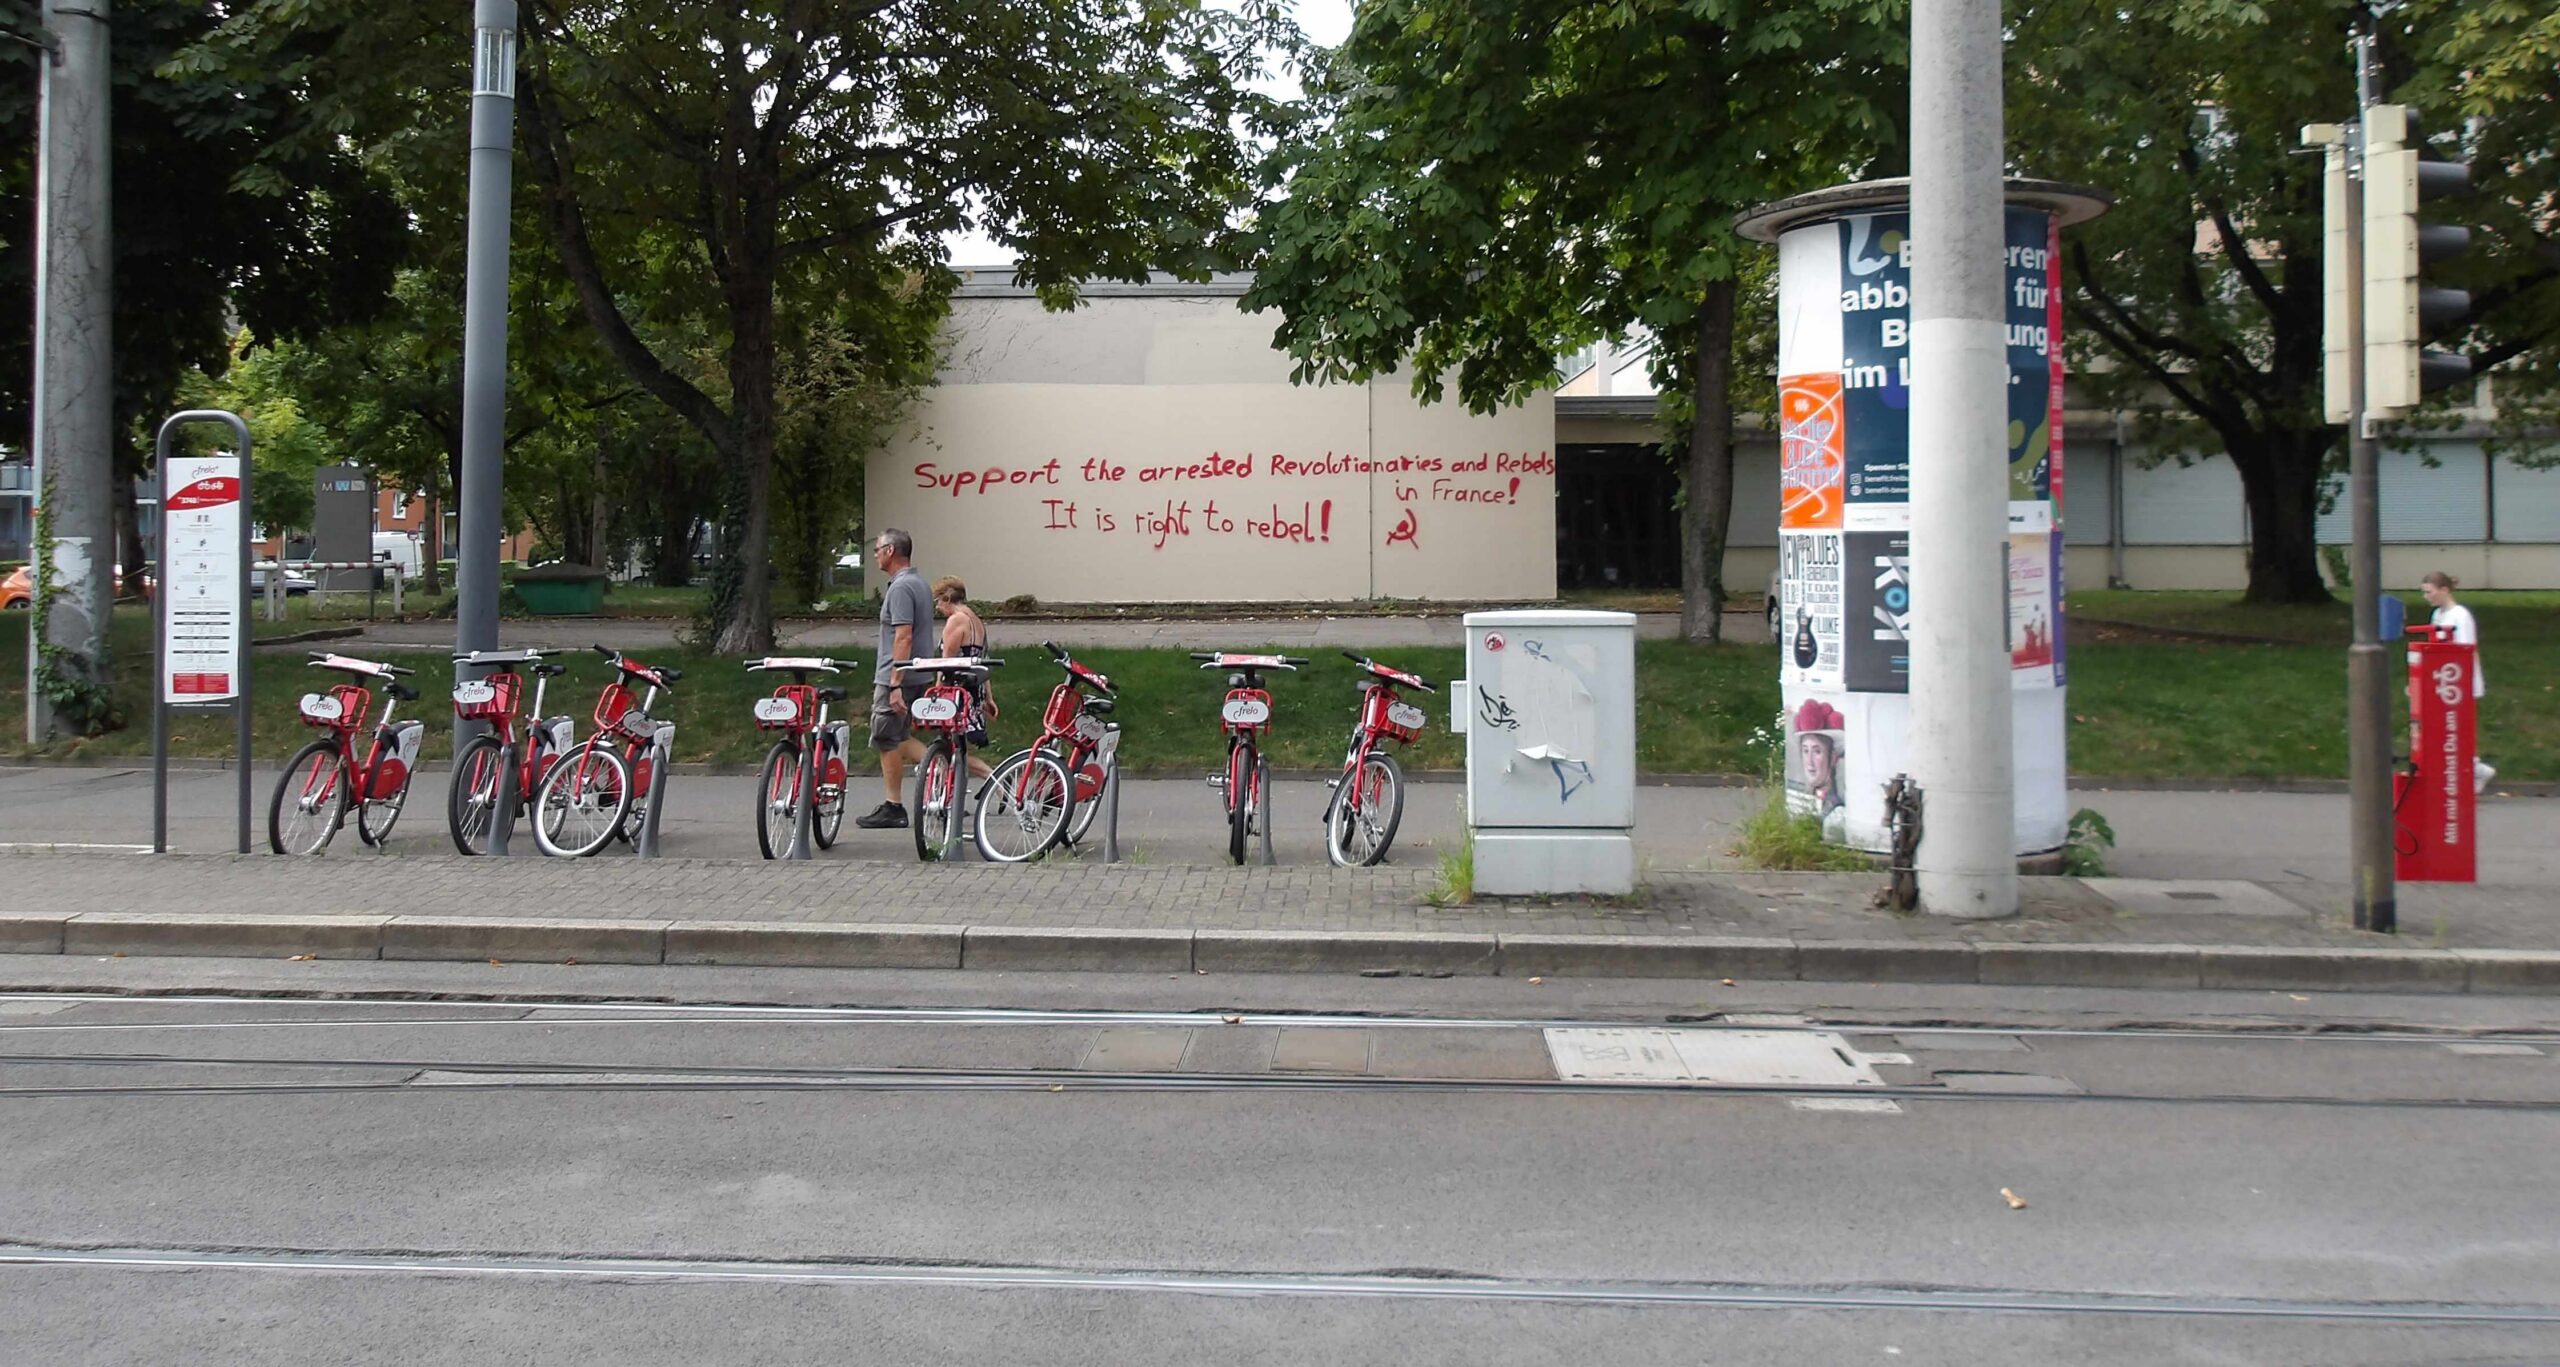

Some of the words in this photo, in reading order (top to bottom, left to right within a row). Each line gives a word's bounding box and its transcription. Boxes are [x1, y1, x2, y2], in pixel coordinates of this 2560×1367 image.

[2014, 277, 2048, 309] für
[1842, 358, 1887, 388] im
[914, 457, 1060, 496] Support
[1081, 457, 1126, 482] the
[1138, 452, 1253, 482] arrested
[1270, 452, 1443, 477] Revolutionaries
[1451, 452, 1488, 473] and
[1496, 451, 1556, 475] Rebels
[1395, 478, 1418, 501] in
[1432, 477, 1521, 505] France!
[1043, 498, 1077, 530] It
[1096, 506, 1117, 532] is
[1136, 499, 1191, 549] right
[1204, 500, 1234, 533] to
[1246, 499, 1332, 545] rebel!
[1806, 535, 1839, 565] BLUES
[463, 686, 485, 701] frelo
[764, 703, 788, 718] frelo
[921, 703, 947, 717] frelo
[1233, 706, 1259, 720] frelo
[2445, 711, 2458, 731] am
[2443, 733, 2458, 753] Du
[2443, 755, 2458, 796] drehst
[2444, 798, 2458, 820] mir
[2443, 821, 2458, 844] Mit
